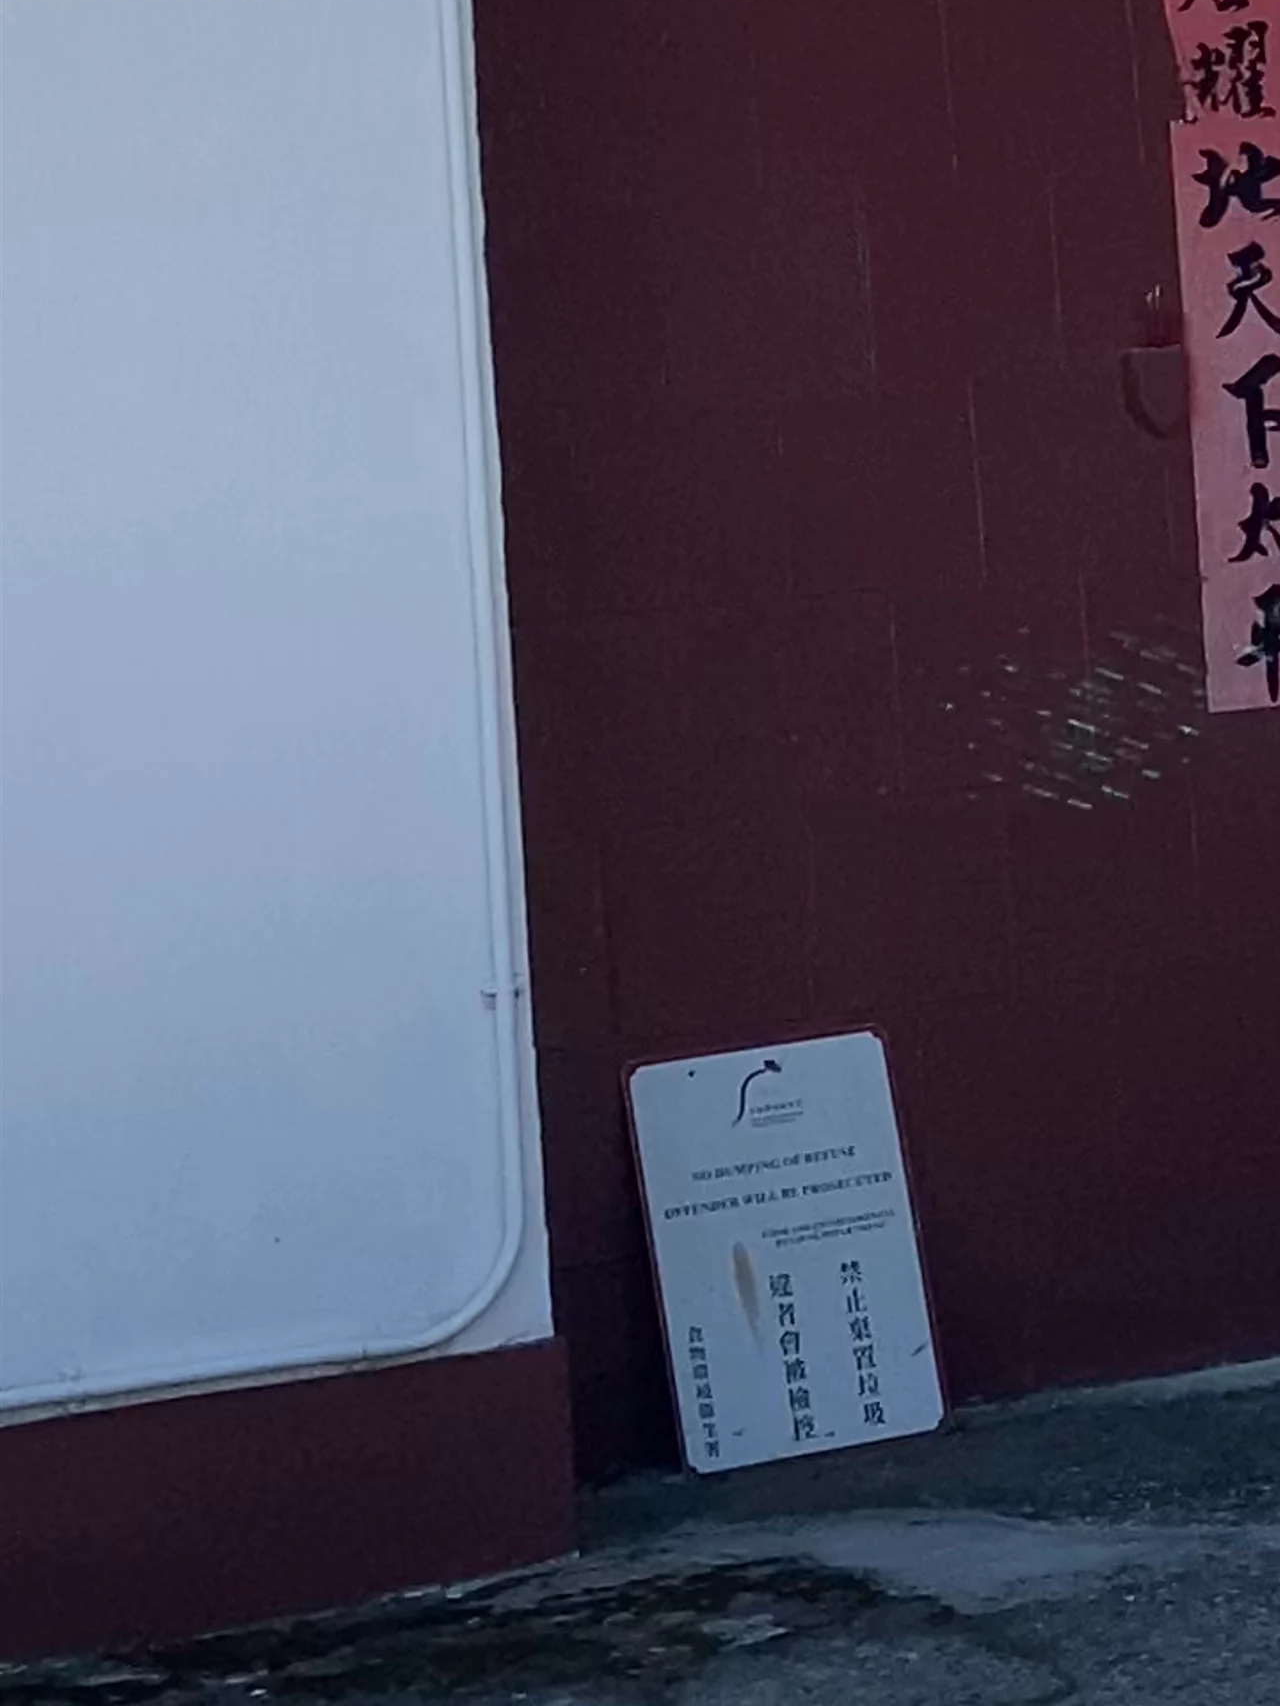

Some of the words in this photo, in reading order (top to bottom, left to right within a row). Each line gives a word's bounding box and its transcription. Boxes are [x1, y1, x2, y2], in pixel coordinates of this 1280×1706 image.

[715, 1158, 780, 1180] DUMPING
[783, 1153, 801, 1167] OF
[804, 1145, 855, 1164] REFUSE
[781, 1186, 801, 1199] BE
